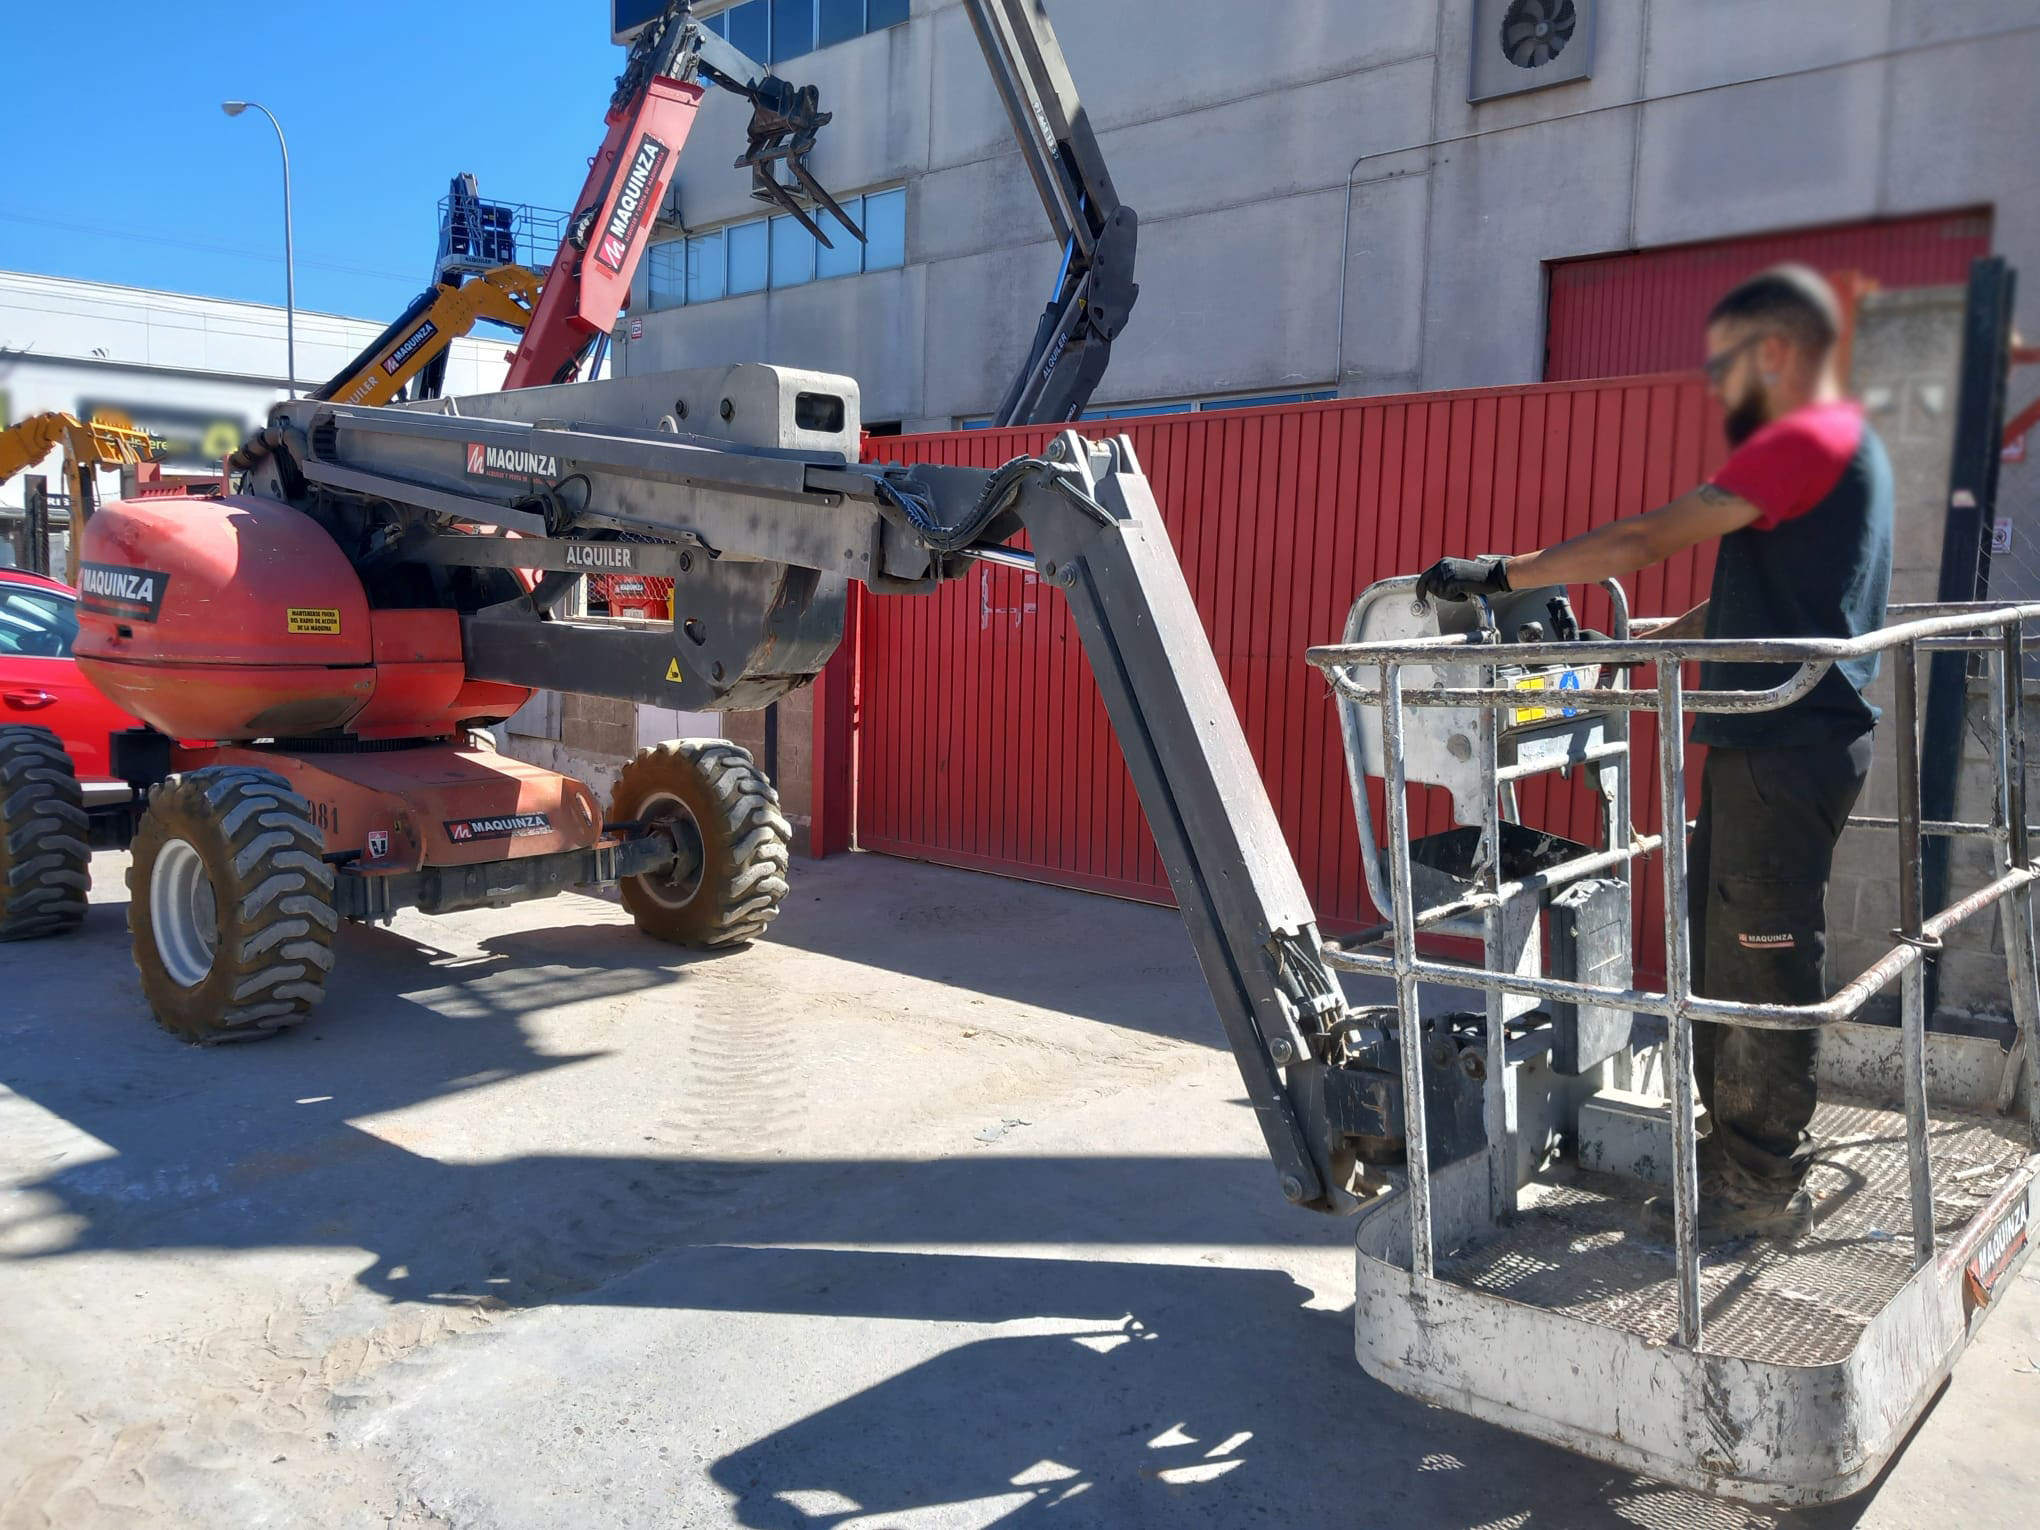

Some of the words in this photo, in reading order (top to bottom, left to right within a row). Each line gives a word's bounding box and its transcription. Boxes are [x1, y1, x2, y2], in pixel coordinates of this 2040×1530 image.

[610, 143, 660, 238] MAQUINZA
[393, 324, 434, 362] MAQUINZA
[1043, 332, 1068, 380] ALQUILER
[345, 376, 379, 404] UILER
[486, 447, 557, 477] MAQUINZA
[566, 546, 631, 567] ALQUILER
[83, 568, 154, 602] MAQUINZA
[471, 816, 545, 833] MAQUINZA
[1748, 933, 1793, 942] MAQUINZA
[1978, 1200, 2027, 1278] MAQUINZA
